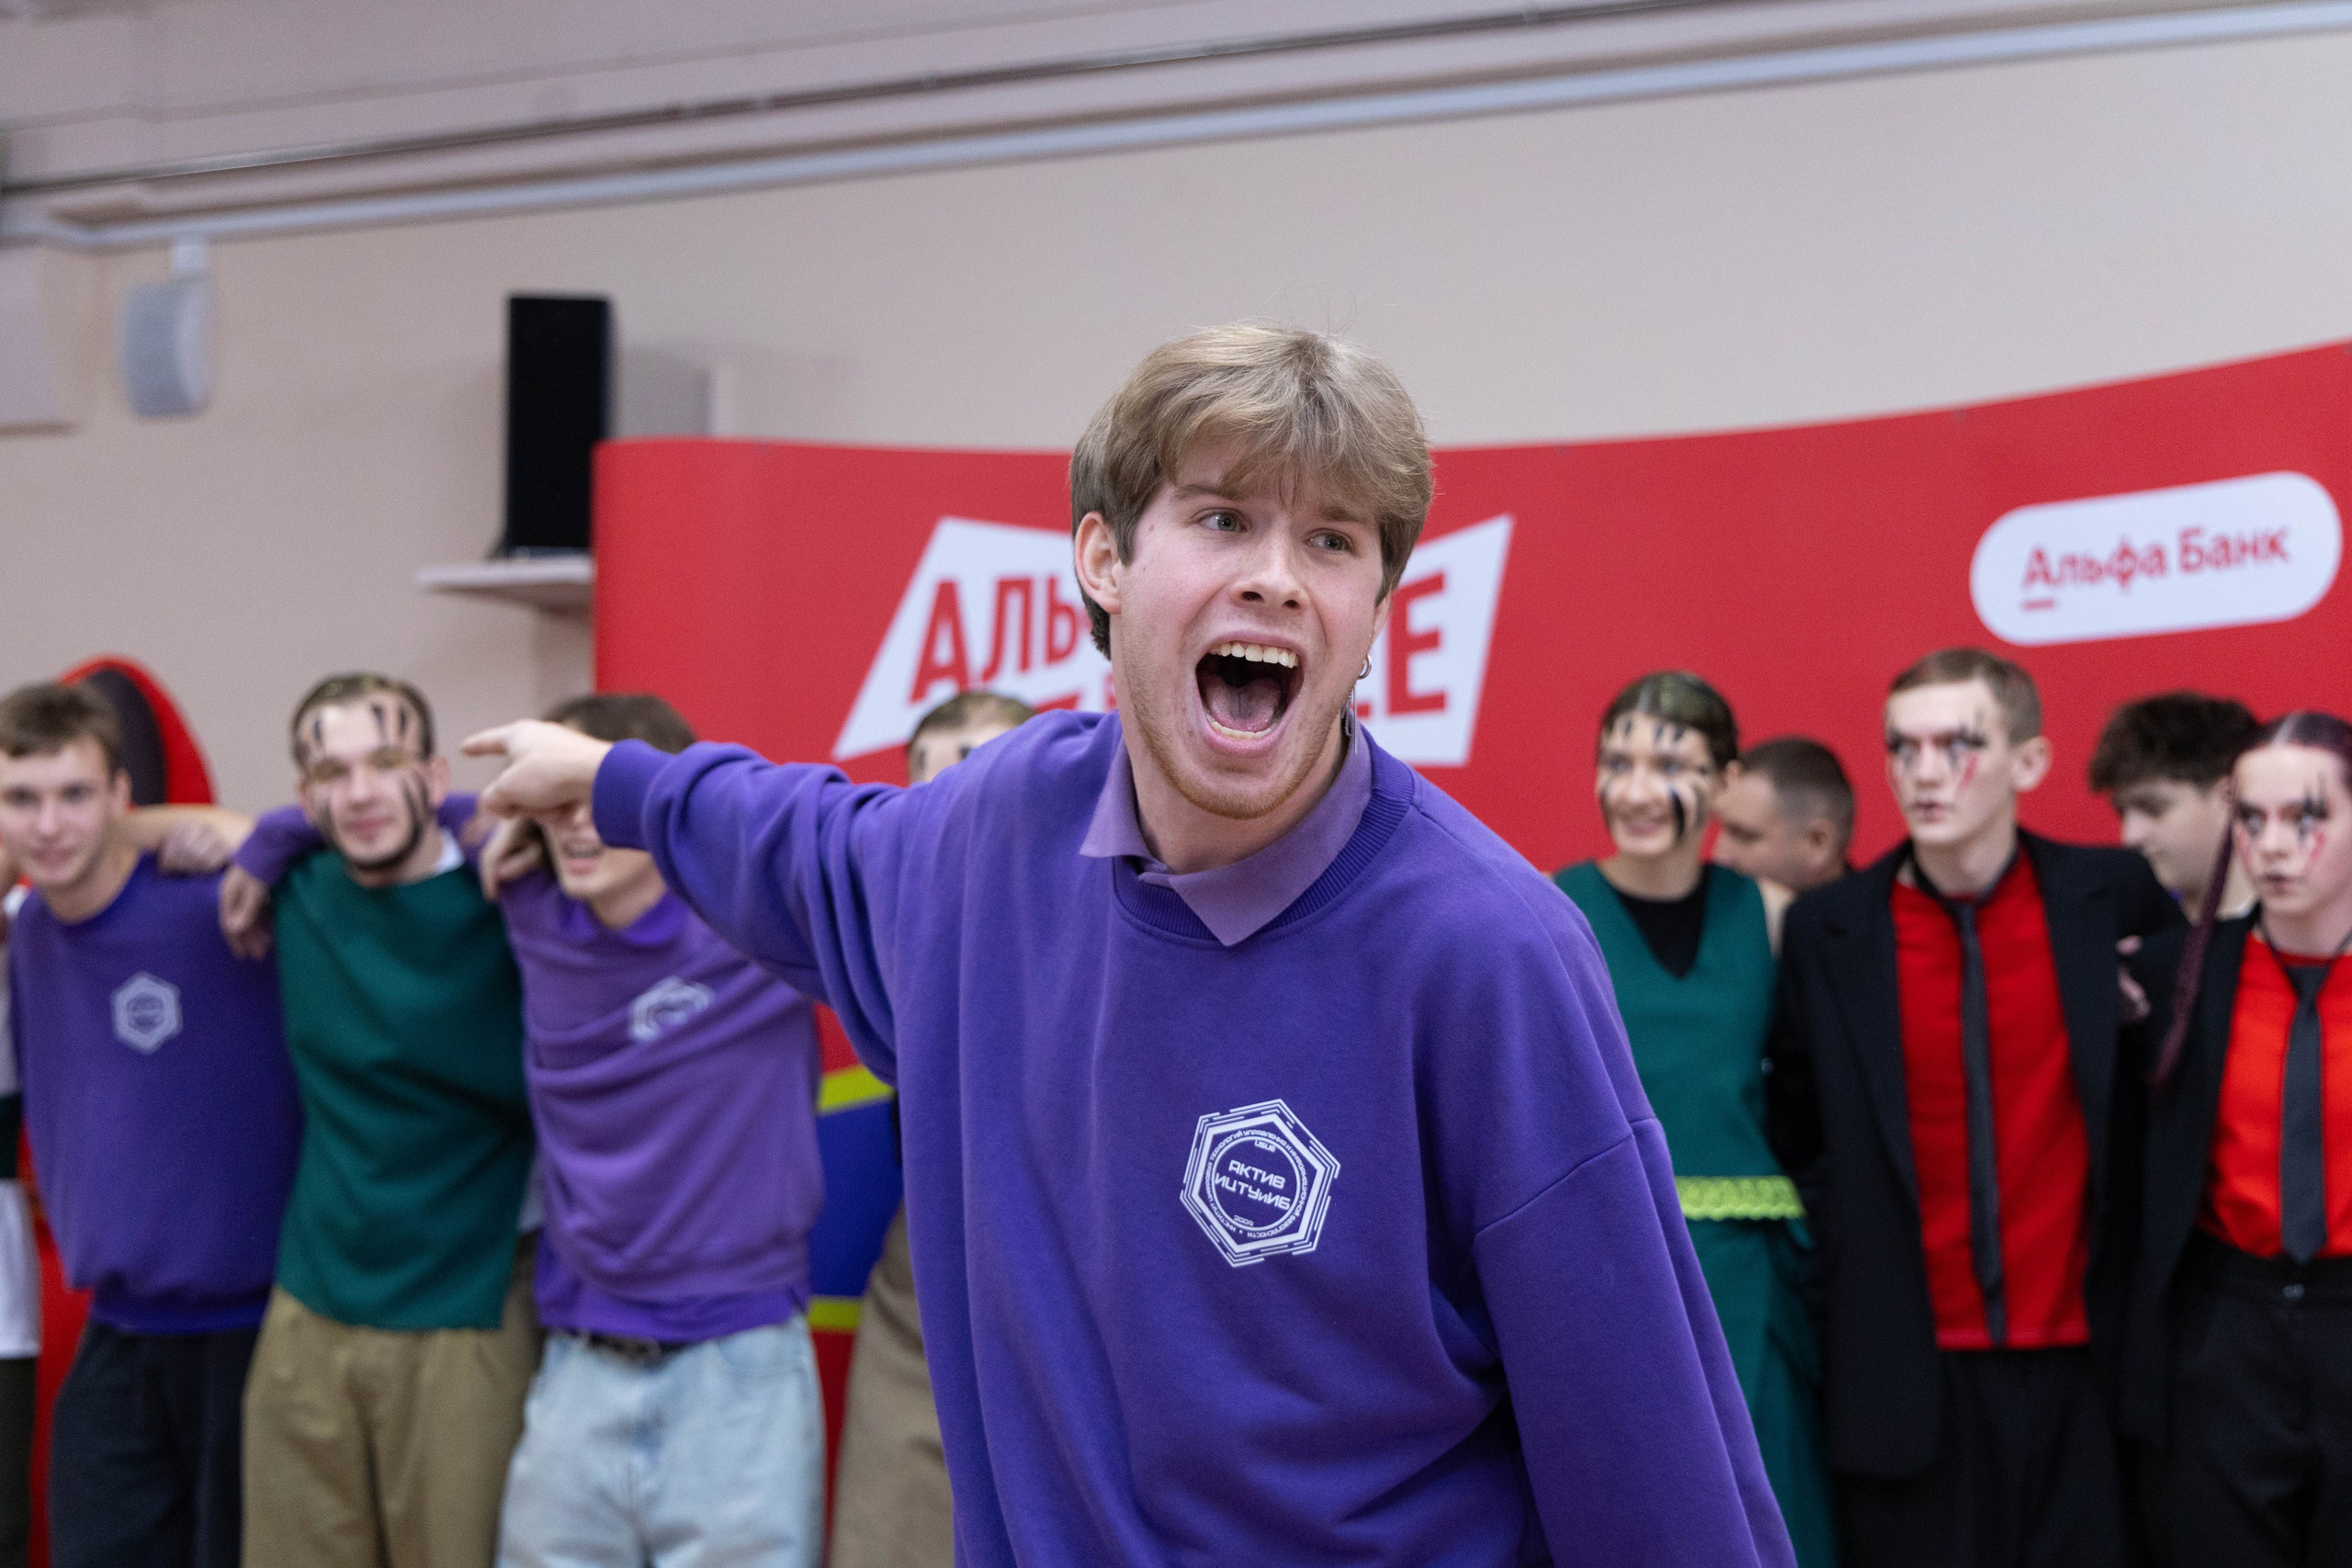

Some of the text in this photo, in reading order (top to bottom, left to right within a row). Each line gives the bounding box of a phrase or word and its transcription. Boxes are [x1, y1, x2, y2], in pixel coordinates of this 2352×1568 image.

[2024, 525, 2290, 596] Альфа Банк
[910, 577, 1091, 705] АЛЬ
[1209, 1130, 1243, 1160] ТЕХНОЛОГИЙ
[1243, 1129, 1287, 1147] УПРАВЛЕНИЯ
[1254, 1139, 1276, 1153] USUE
[1228, 1159, 1286, 1190] АКТИВ
[1234, 1214, 1254, 1227] 2009
